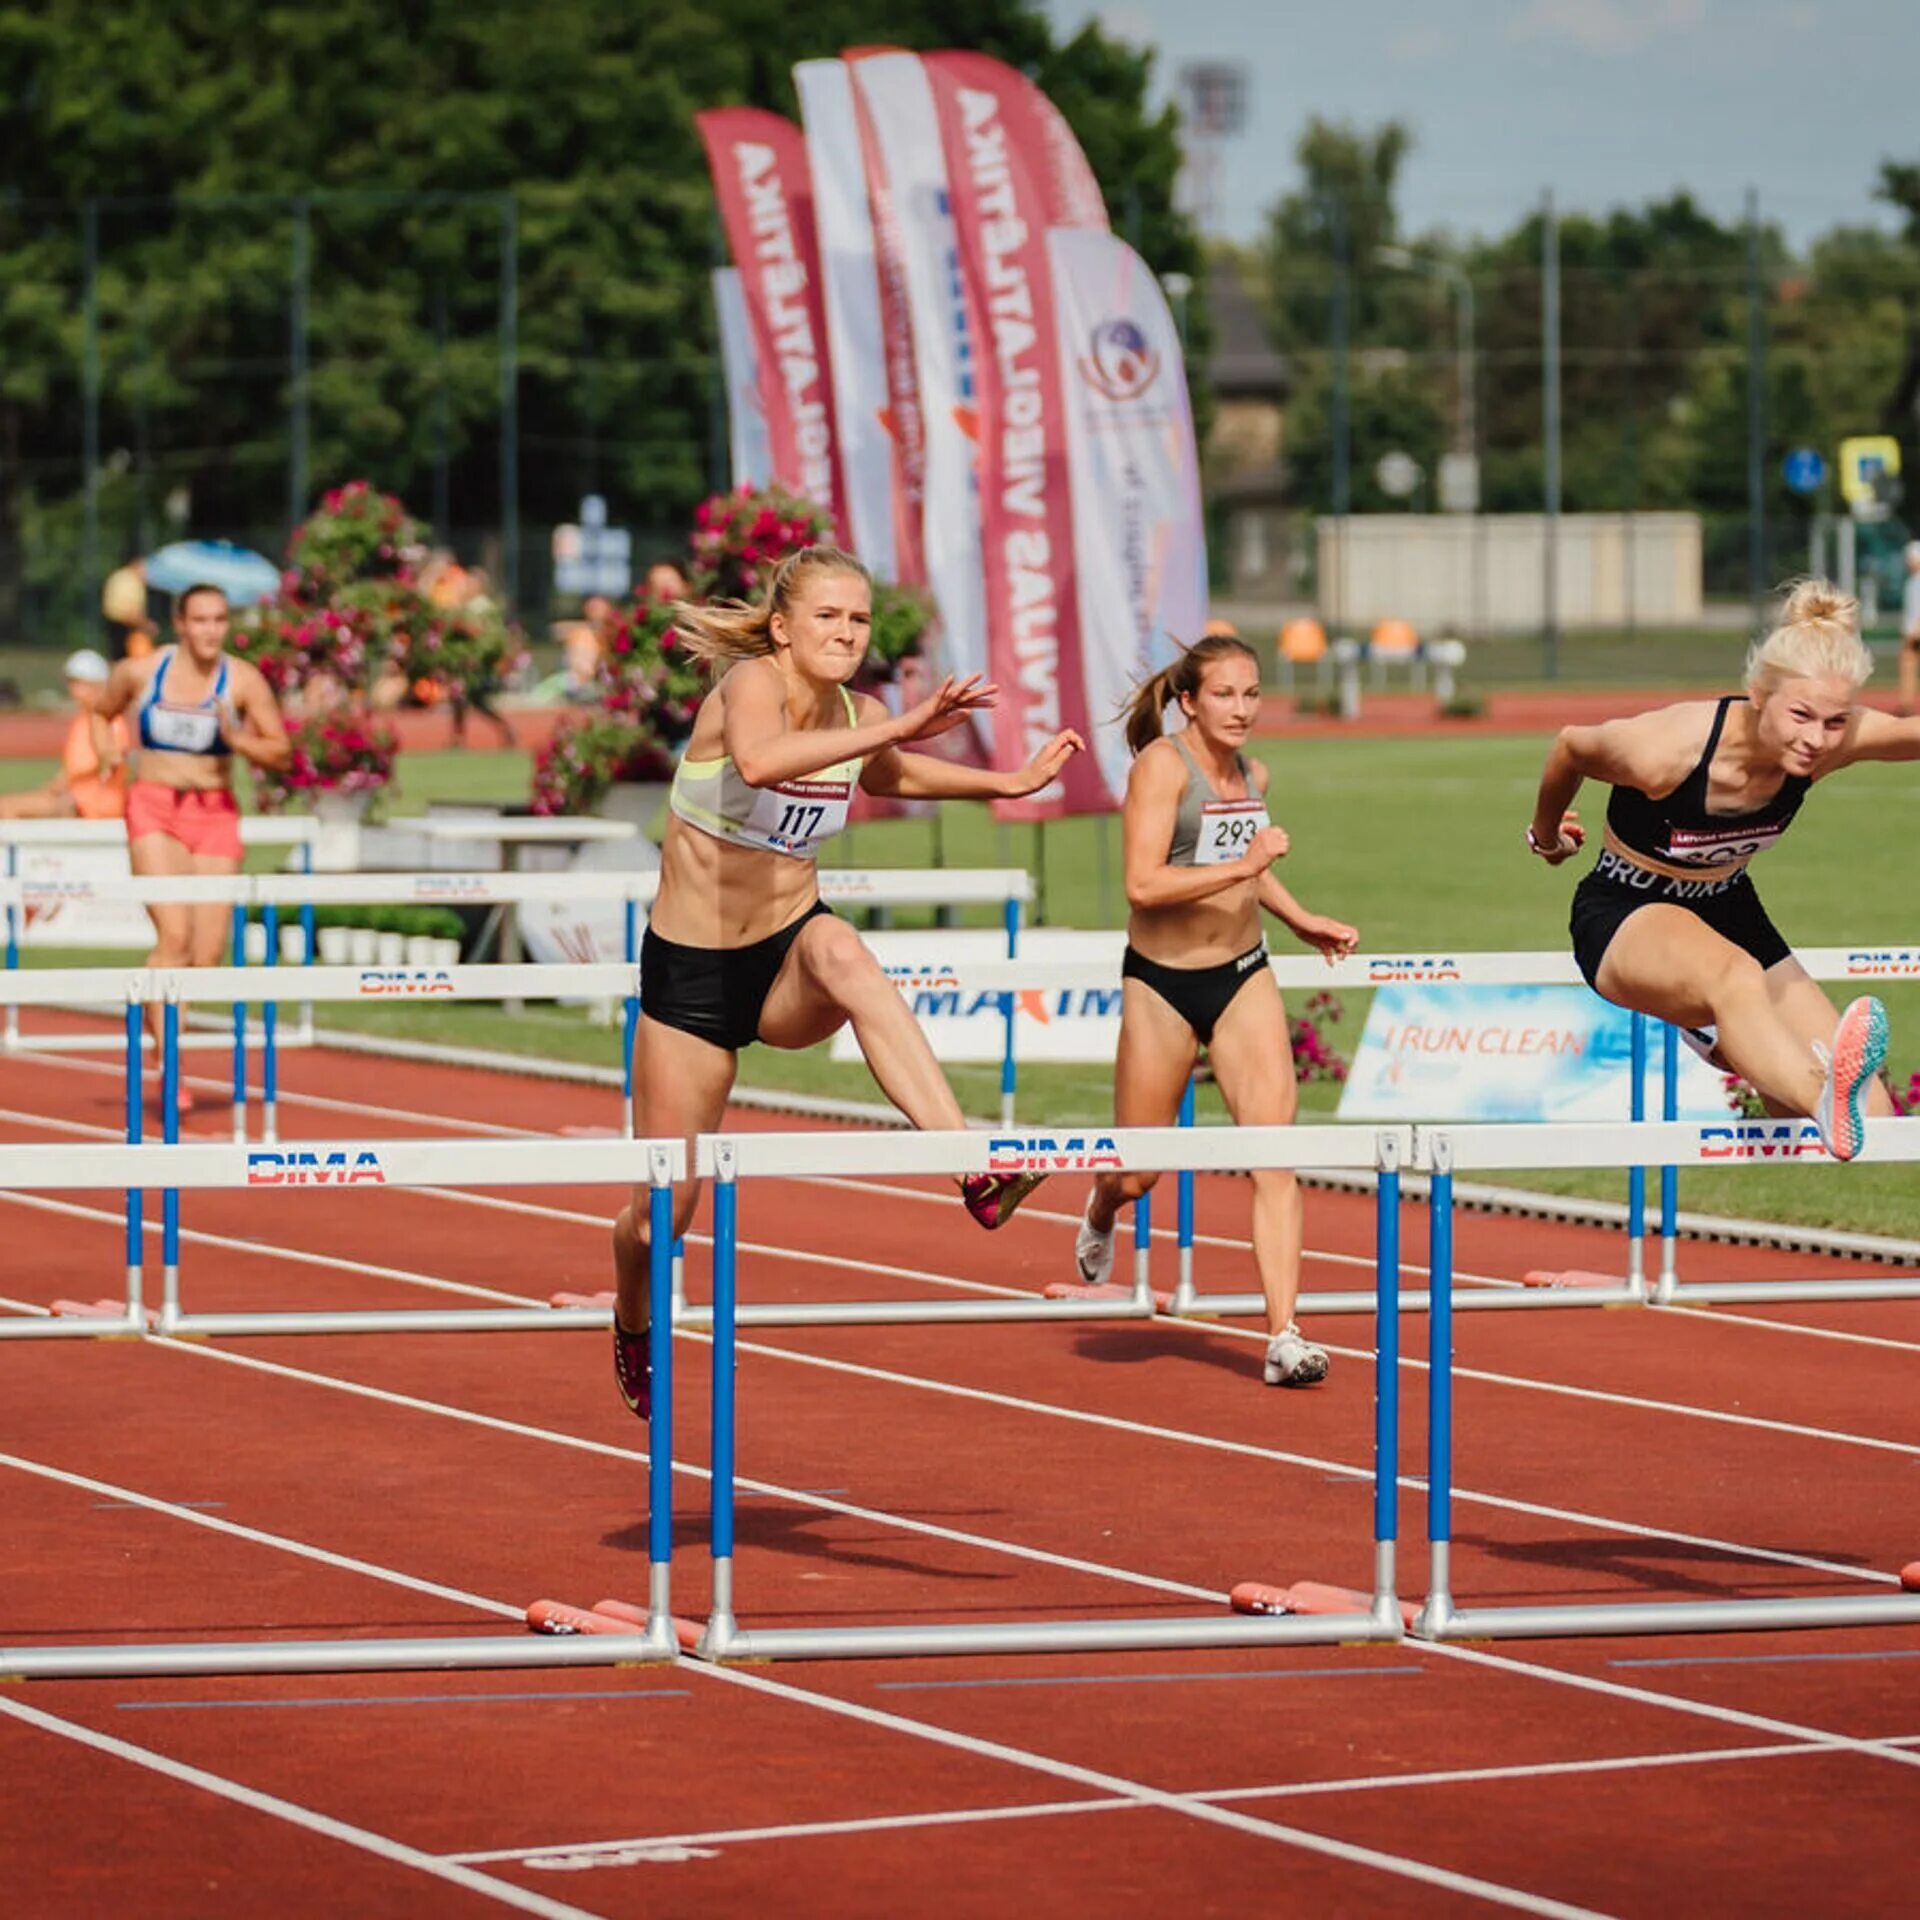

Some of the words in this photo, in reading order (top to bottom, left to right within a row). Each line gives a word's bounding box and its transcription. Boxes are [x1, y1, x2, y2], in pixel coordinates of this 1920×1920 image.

[779, 804, 826, 838] 117
[1213, 819, 1258, 847] 293
[361, 972, 455, 993] DIMA
[882, 966, 959, 987] IMA
[1369, 960, 1460, 981] DIMA
[1384, 1025, 1396, 1050] I
[1400, 1025, 1472, 1052] RUN
[1477, 1027, 1588, 1056] CLEAN
[989, 1137, 1123, 1168] DIMA
[1700, 1126, 1827, 1157] DIMA
[247, 1152, 385, 1183] DIMA
